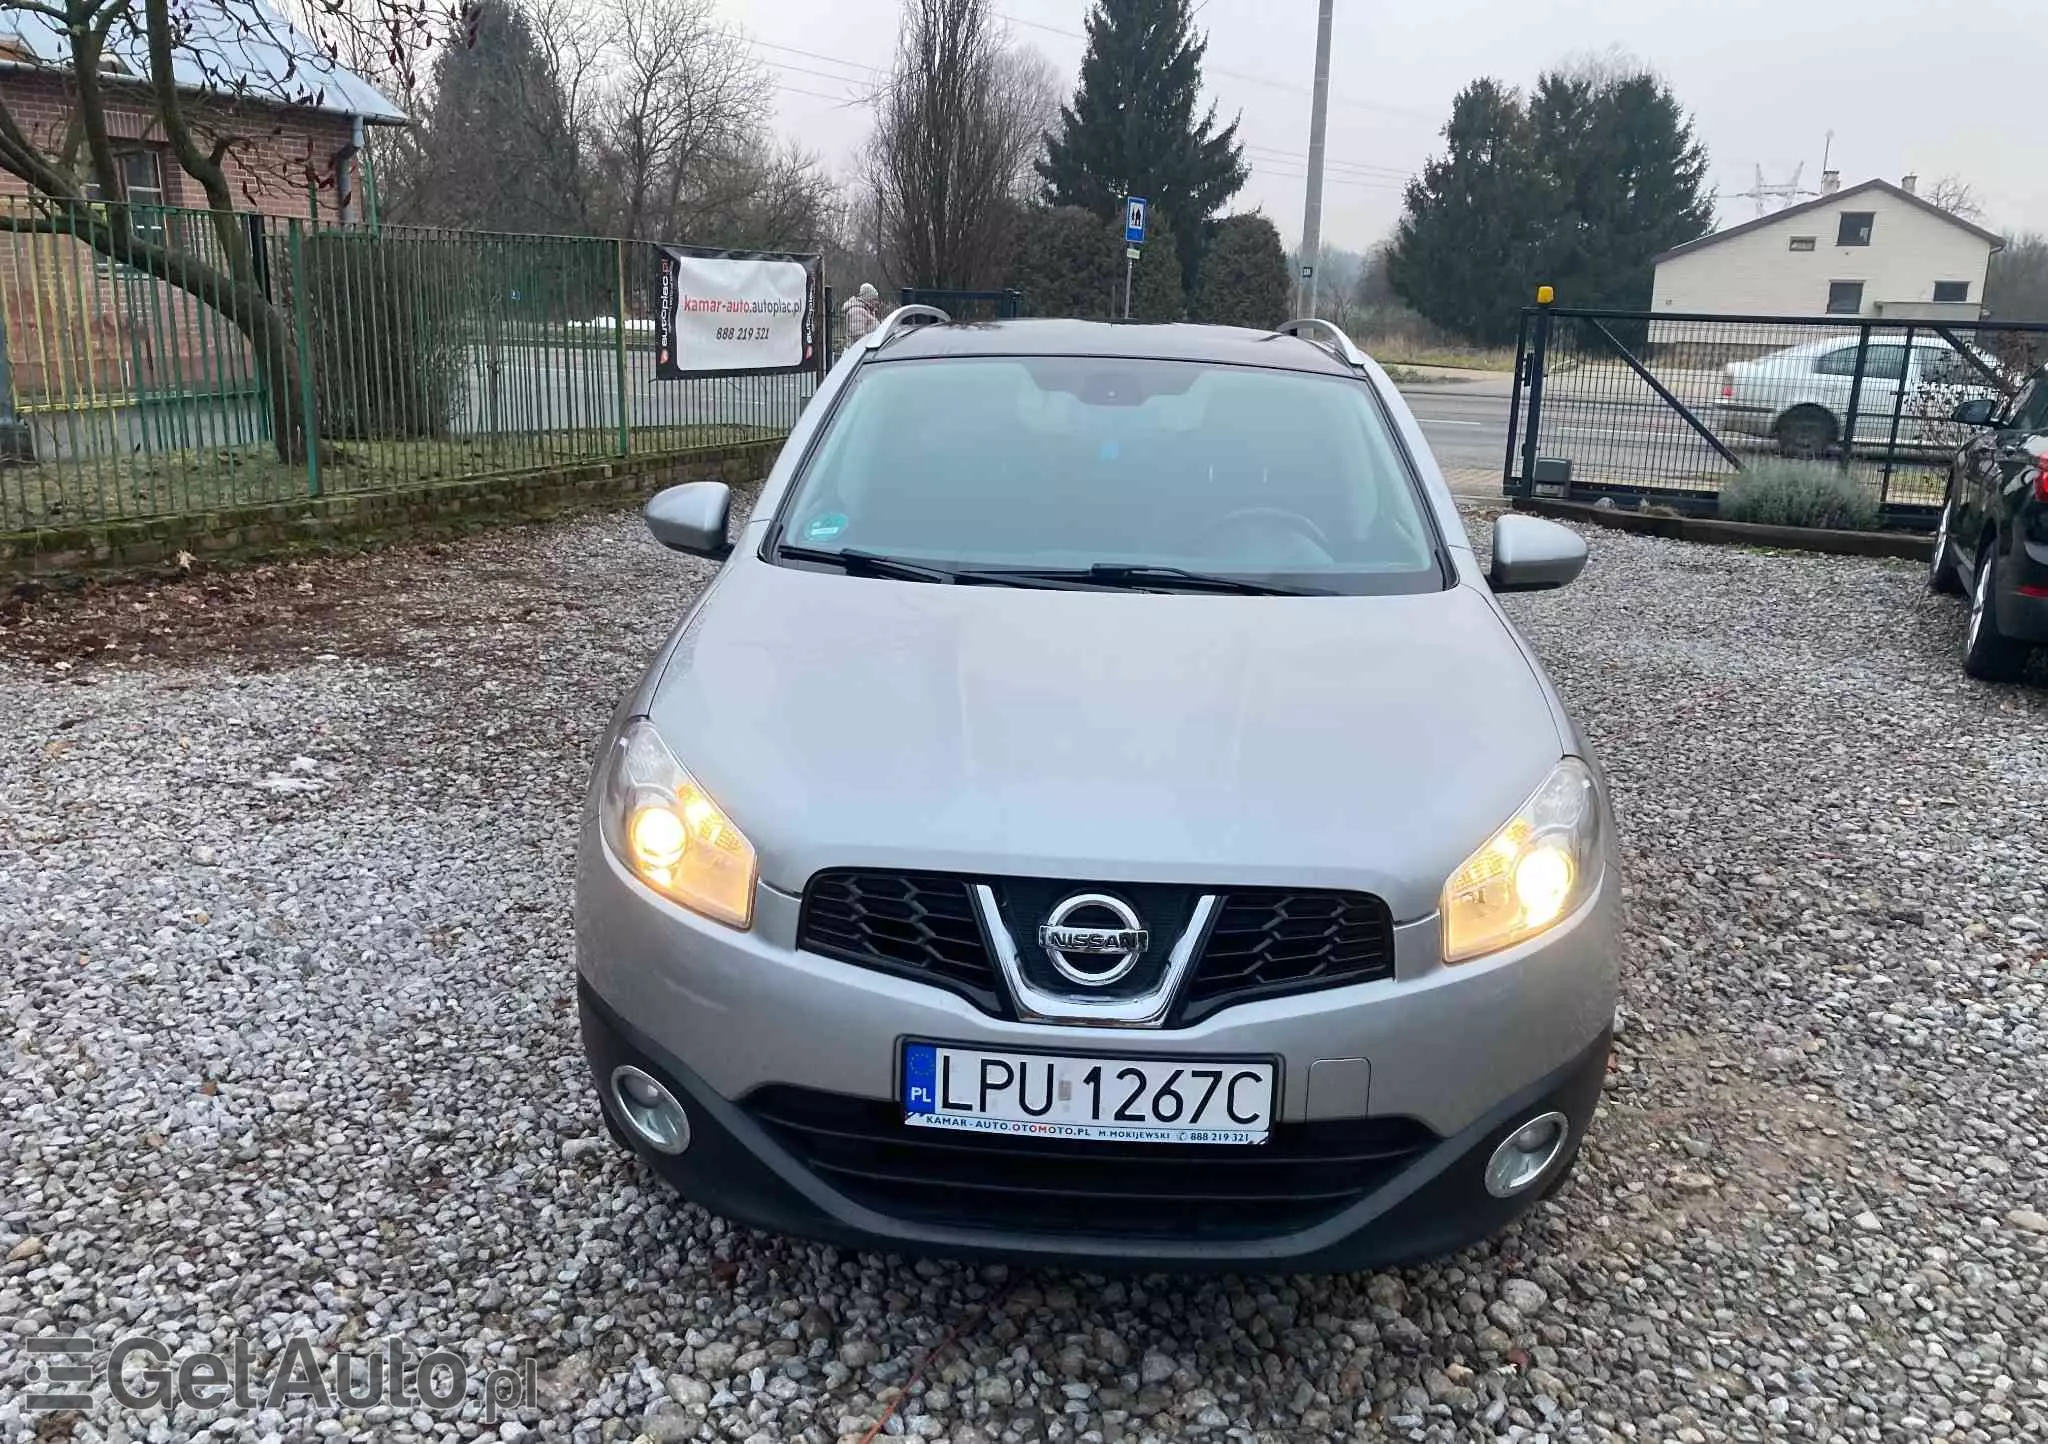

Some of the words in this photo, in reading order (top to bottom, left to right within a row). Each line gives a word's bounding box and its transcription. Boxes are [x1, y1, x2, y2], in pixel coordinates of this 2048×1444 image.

[684, 294, 802, 317] kamar-auto.autoplac.pl
[716, 327, 735, 341] 888
[737, 327, 753, 341] 219
[755, 327, 770, 341] 321
[1051, 931, 1137, 949] NISSAN
[911, 1087, 931, 1103] PL
[941, 1055, 1054, 1116] LPU
[1083, 1066, 1263, 1124] 1267C
[1190, 1132, 1208, 1141] 888
[1211, 1133, 1229, 1142] 219
[1232, 1133, 1249, 1143] 321
